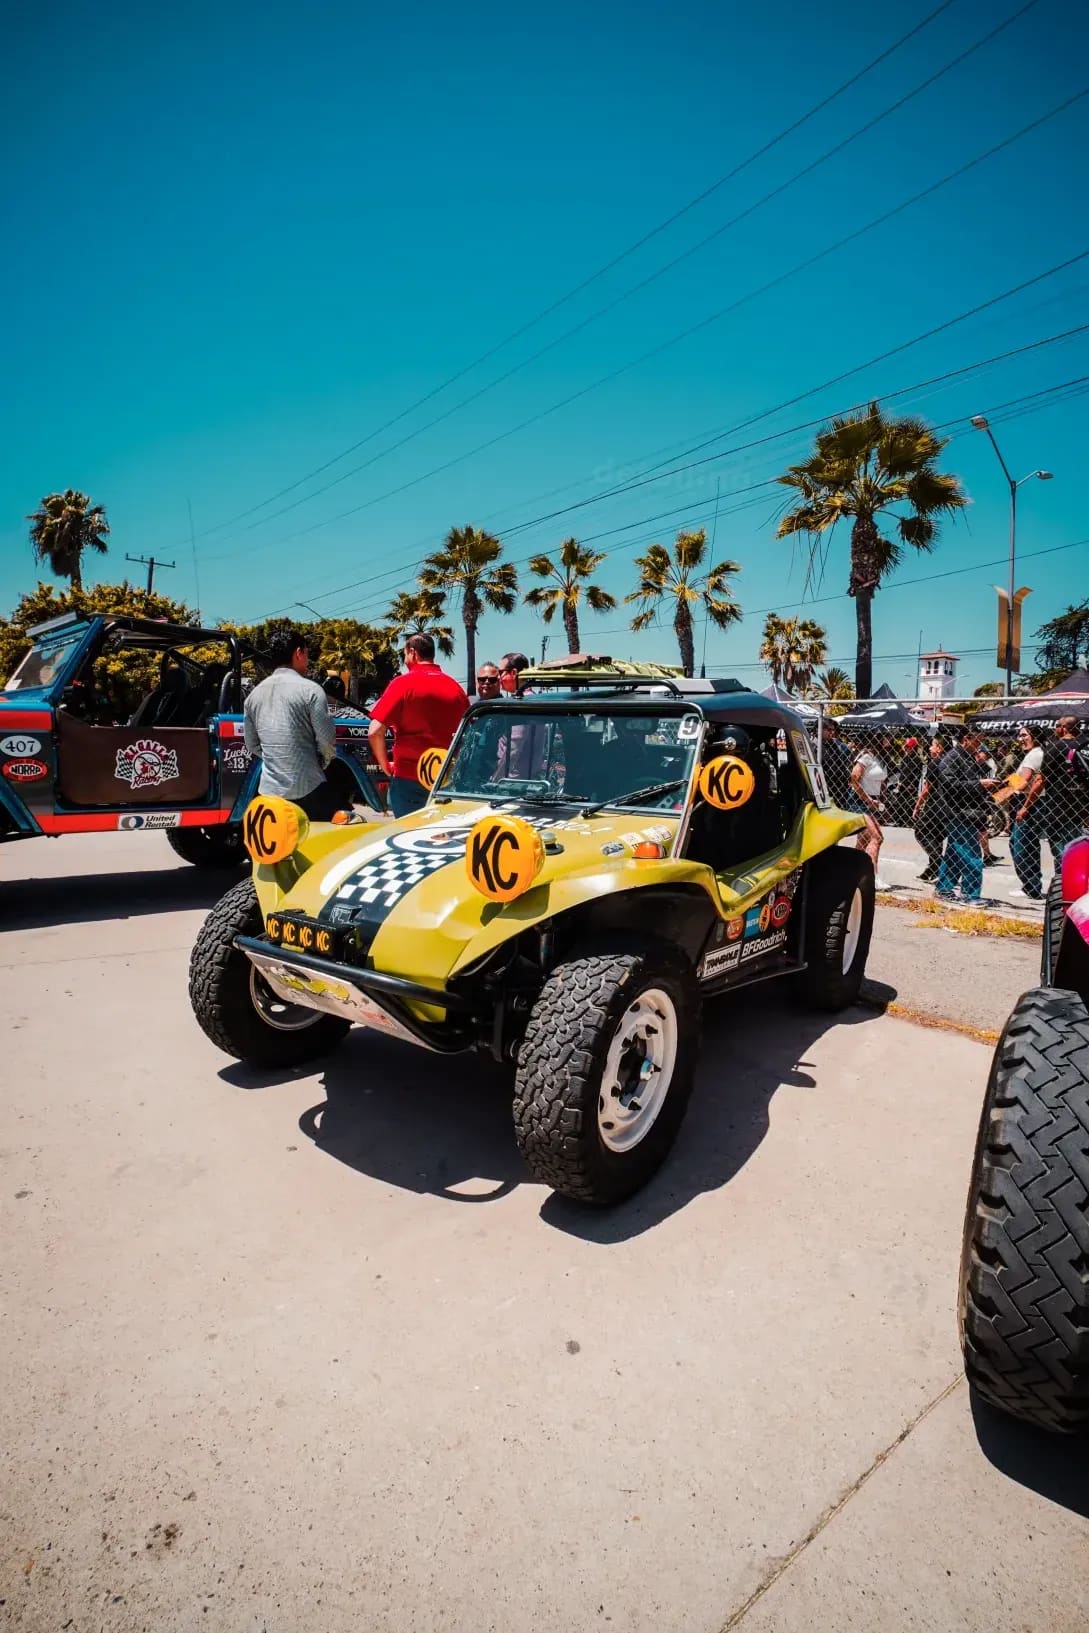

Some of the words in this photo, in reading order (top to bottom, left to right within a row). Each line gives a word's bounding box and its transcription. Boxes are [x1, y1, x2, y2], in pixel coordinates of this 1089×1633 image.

[682, 716, 699, 736] 9
[5, 740, 36, 753] 407
[223, 745, 253, 761] Lucky
[233, 757, 245, 769] 13
[420, 753, 442, 786] KC
[707, 761, 745, 804] KC
[144, 821, 177, 829] Rentals
[145, 814, 176, 822] United
[247, 804, 277, 858] KC
[471, 825, 520, 893] KC
[267, 918, 279, 938] KC
[283, 922, 295, 942] KC
[299, 926, 312, 947] KC
[316, 930, 330, 951] KC
[743, 930, 786, 956] BFGoodrich
